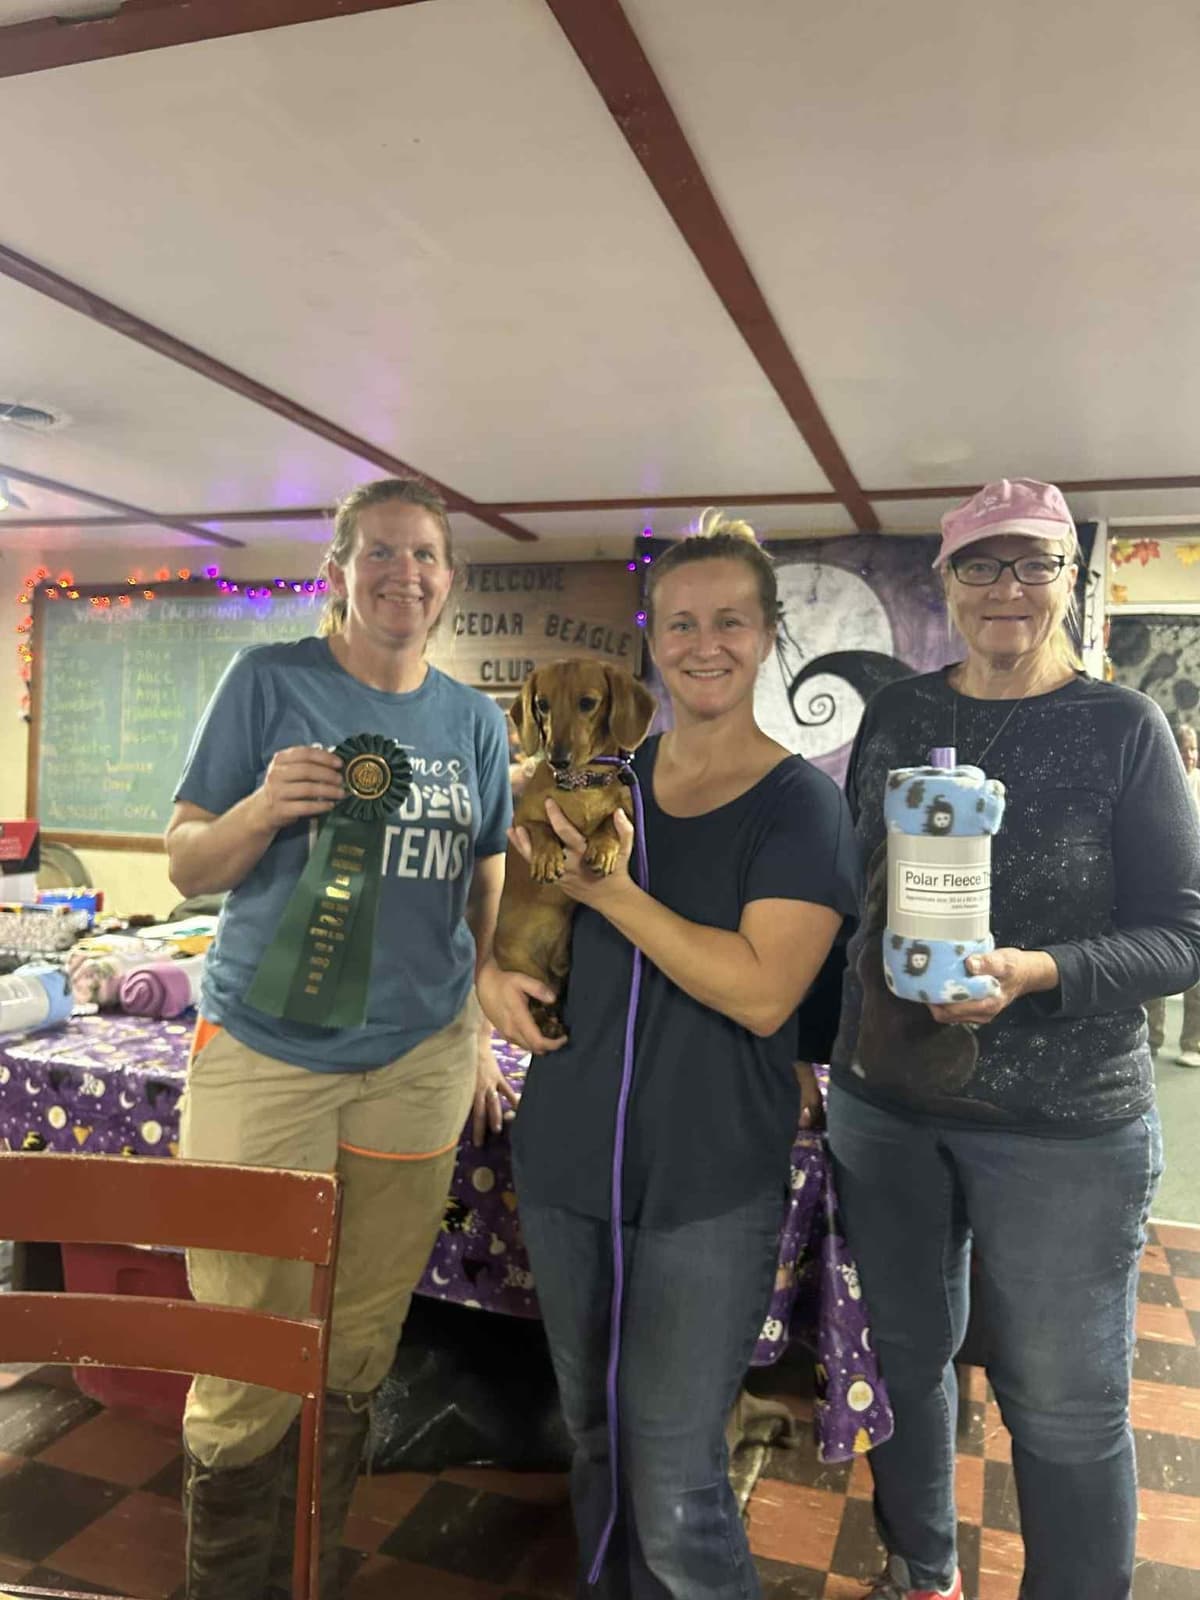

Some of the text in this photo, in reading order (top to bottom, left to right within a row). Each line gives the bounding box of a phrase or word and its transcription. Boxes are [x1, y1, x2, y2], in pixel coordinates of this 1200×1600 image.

[454, 612, 633, 657] CEDAR BEAGLE
[905, 871, 939, 887] Polar
[943, 873, 981, 887] Fleece
